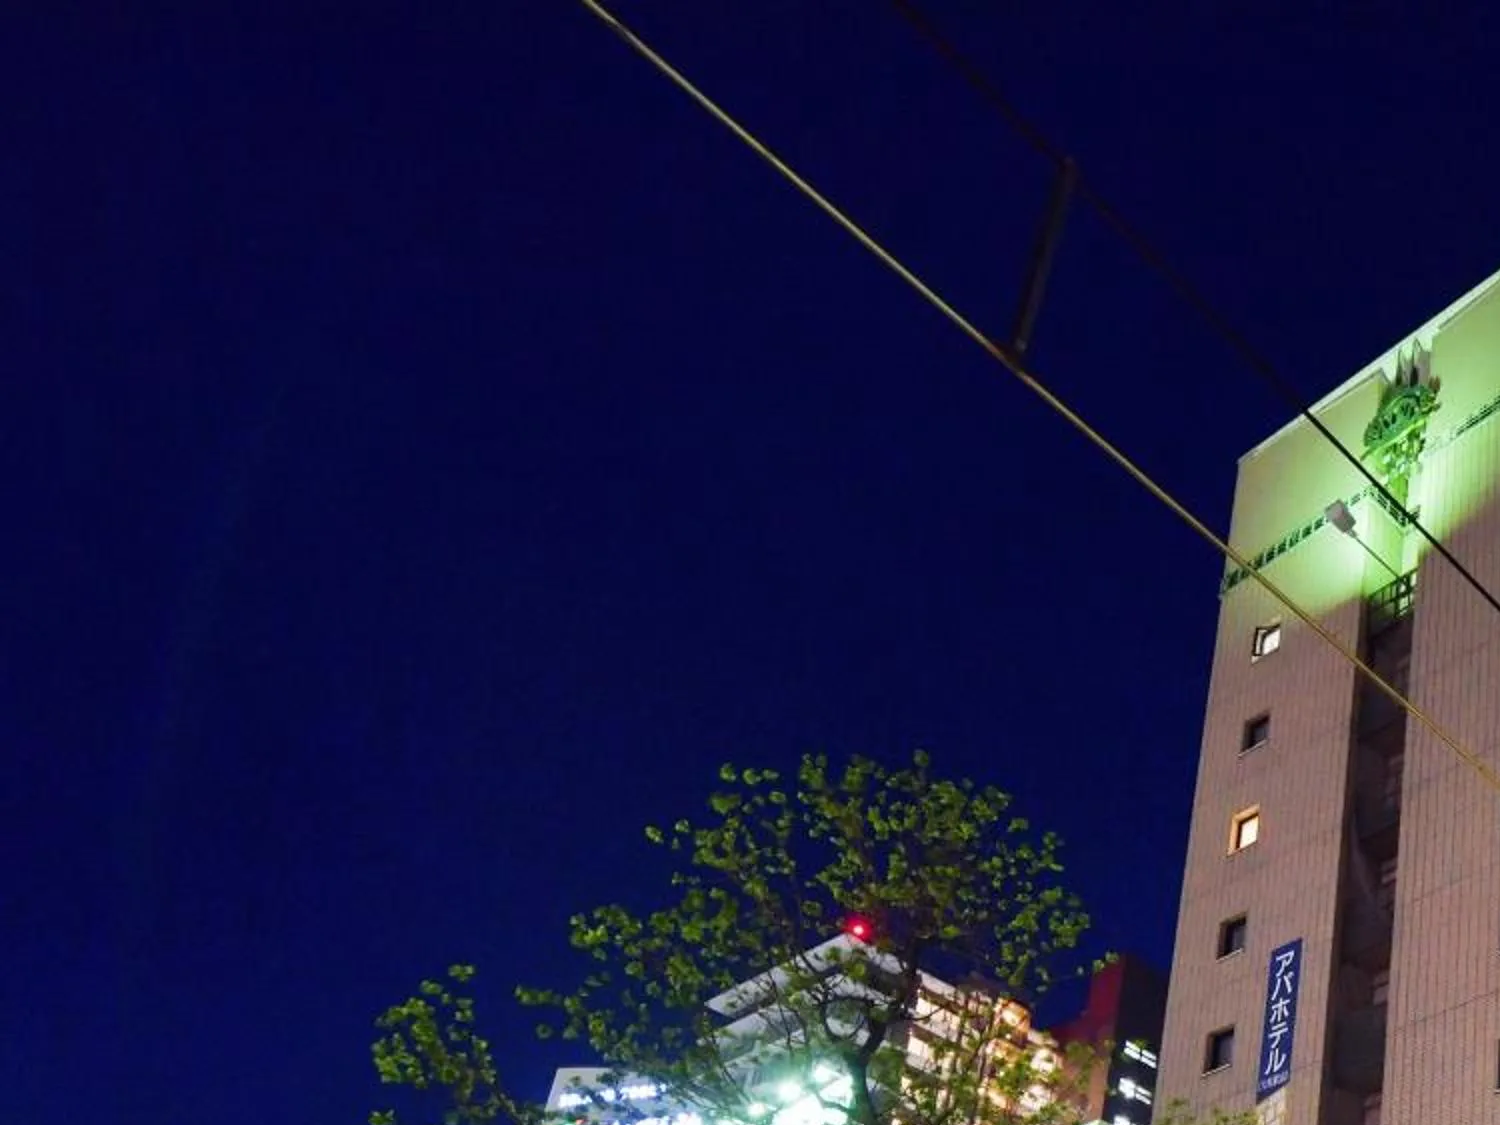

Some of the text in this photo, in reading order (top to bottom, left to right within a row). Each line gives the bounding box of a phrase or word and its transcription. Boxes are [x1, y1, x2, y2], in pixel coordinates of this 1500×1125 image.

[1263, 950, 1296, 1076] アパホテル
